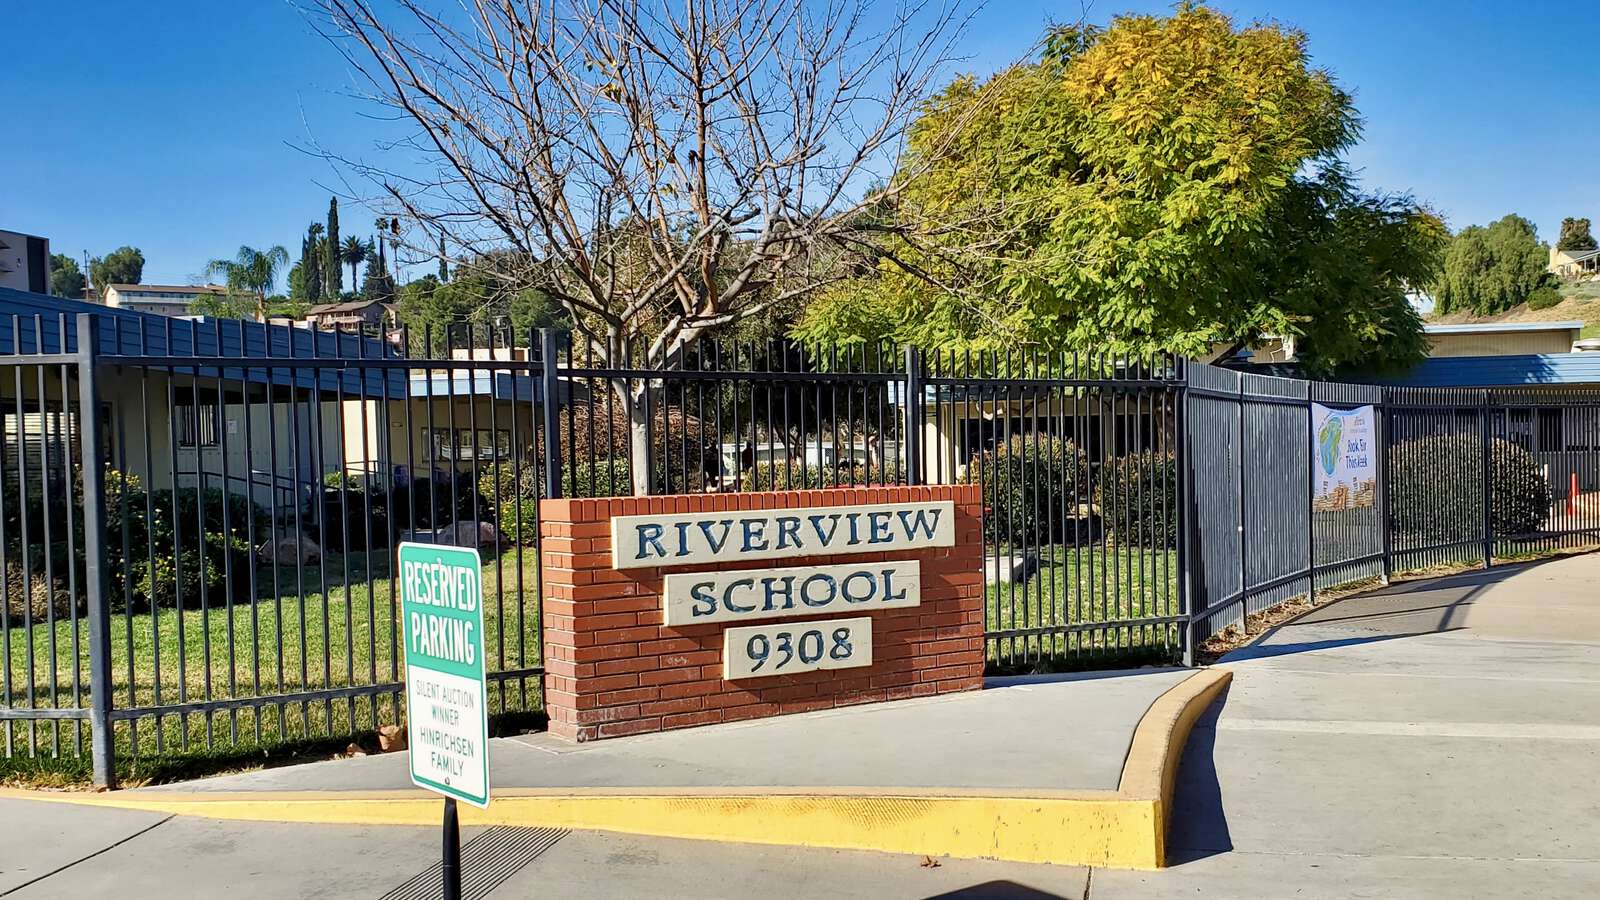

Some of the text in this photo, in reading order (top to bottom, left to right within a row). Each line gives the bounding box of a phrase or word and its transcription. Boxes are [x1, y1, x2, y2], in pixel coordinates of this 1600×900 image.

[634, 508, 942, 560] RIVERVIEW
[404, 560, 477, 612] RESERVED
[690, 569, 907, 617] SCHOOL
[411, 611, 475, 666] PARKING
[747, 627, 853, 673] 9308
[416, 679, 474, 709] SILENT AUCTION
[431, 704, 459, 727] WINNER
[420, 726, 474, 758] HINRICHSEN
[431, 751, 464, 777] FAMILY
